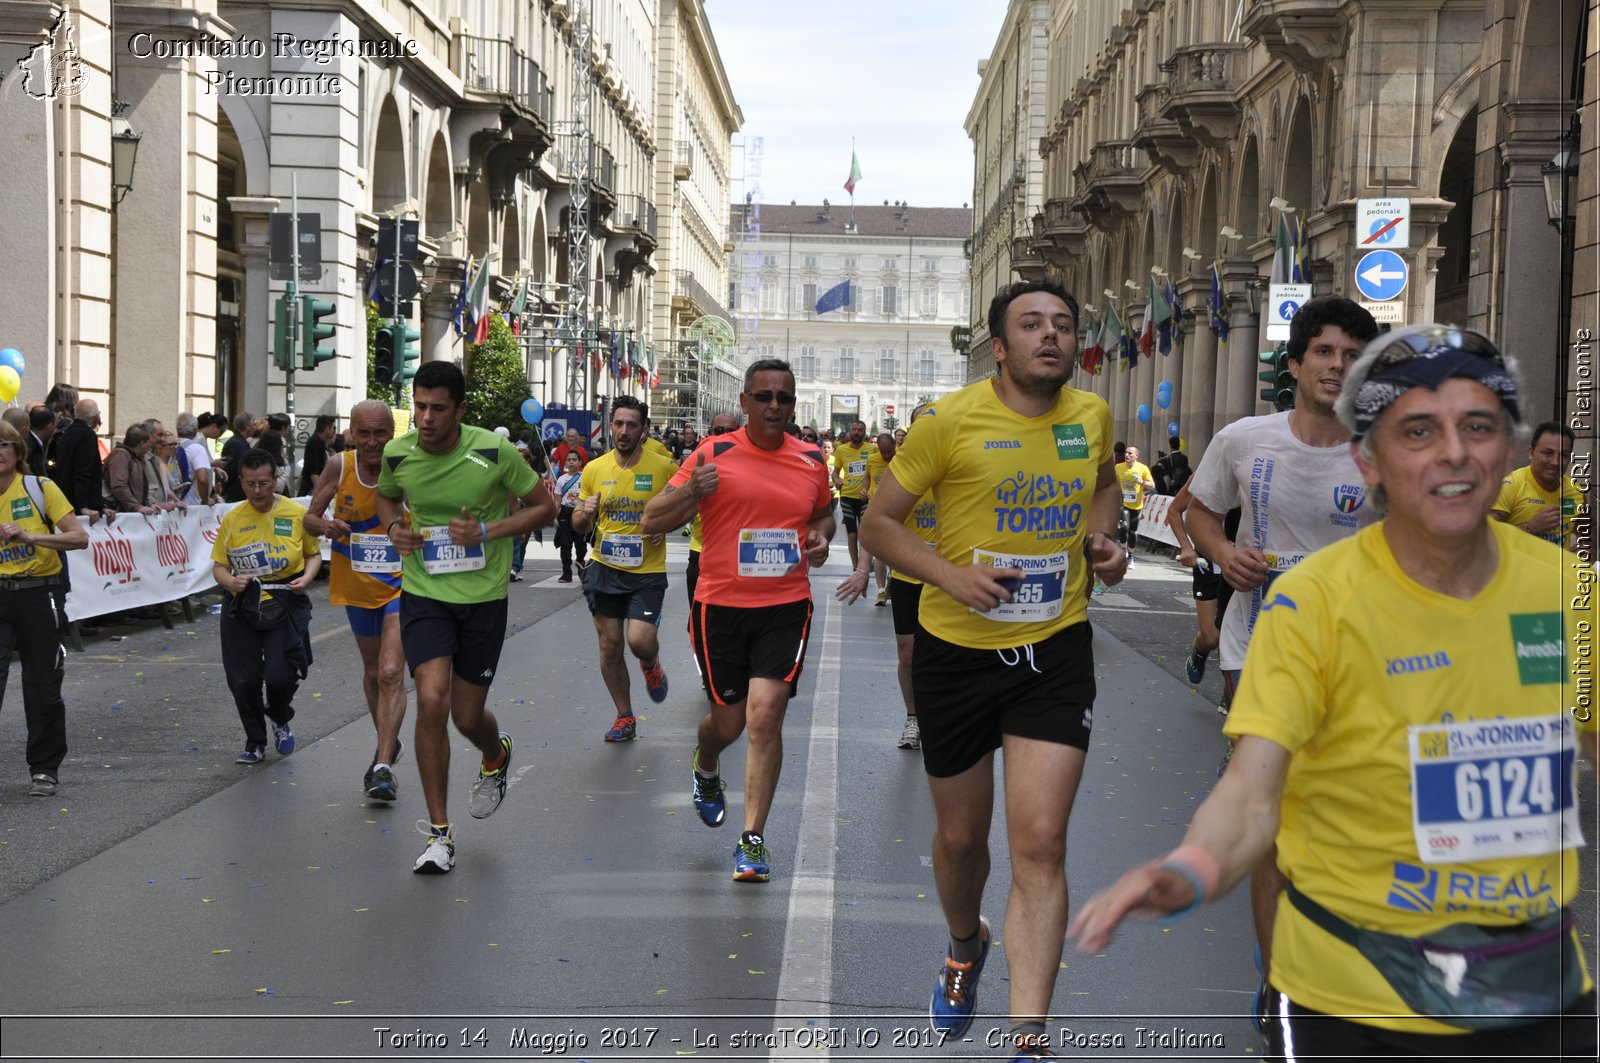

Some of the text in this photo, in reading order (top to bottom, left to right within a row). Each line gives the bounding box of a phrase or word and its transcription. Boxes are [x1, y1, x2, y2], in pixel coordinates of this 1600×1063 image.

[1057, 437, 1087, 447] Arredo3
[1251, 457, 1265, 479] 2012
[1263, 459, 1276, 482] MONATE
[1261, 492, 1270, 508] LAGO
[994, 503, 1082, 533] TORINO
[364, 549, 387, 562] 322
[437, 544, 466, 560] 4579
[611, 548, 631, 558] 1426
[755, 549, 786, 564] 4600
[1454, 756, 1555, 822] 6124
